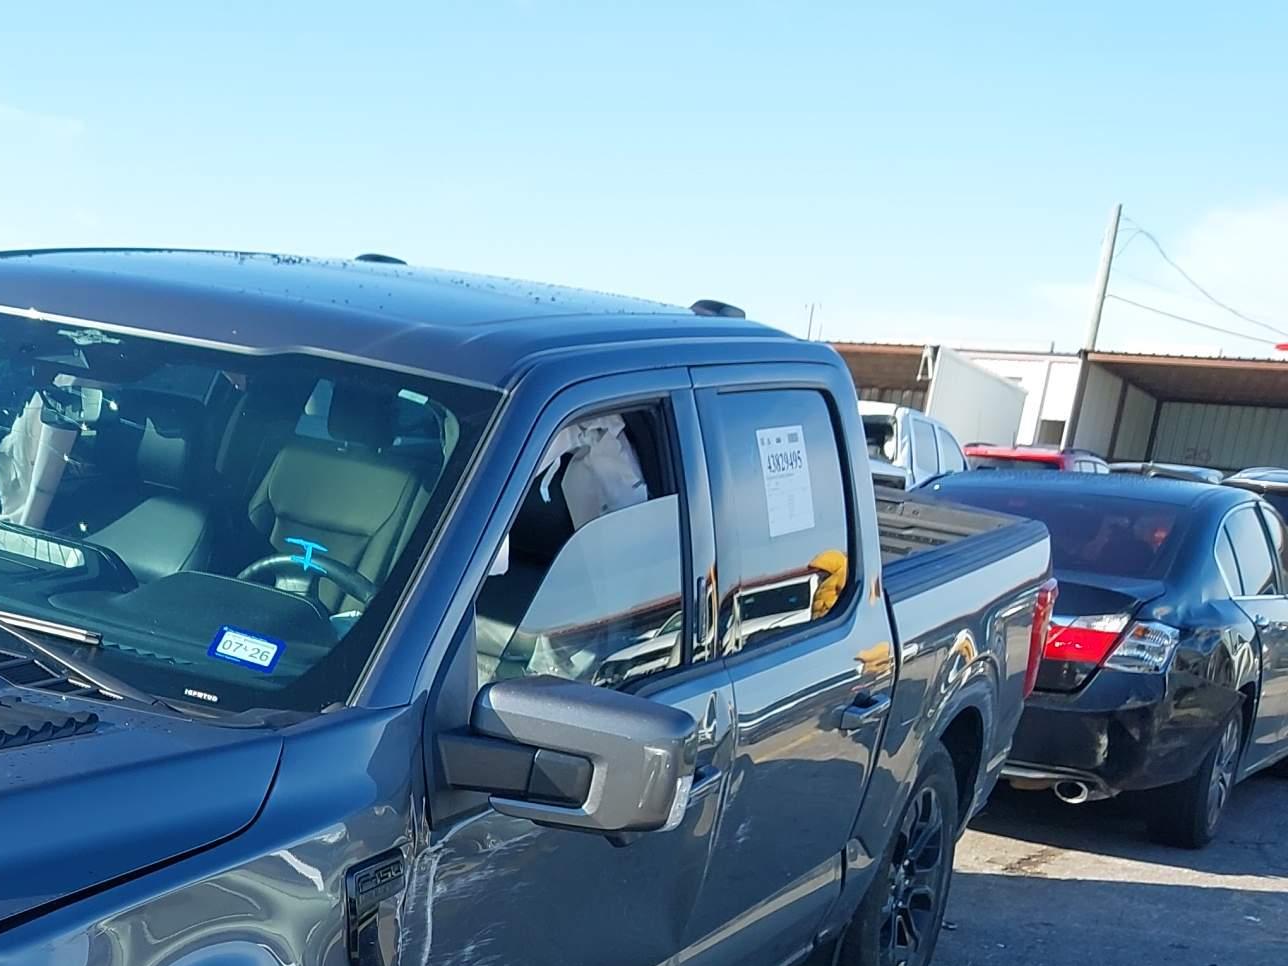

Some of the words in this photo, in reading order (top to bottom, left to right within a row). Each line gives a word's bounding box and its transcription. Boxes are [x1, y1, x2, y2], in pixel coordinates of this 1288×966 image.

[767, 451, 803, 473] 43829495
[222, 640, 243, 652] 07
[249, 648, 270, 662] 26
